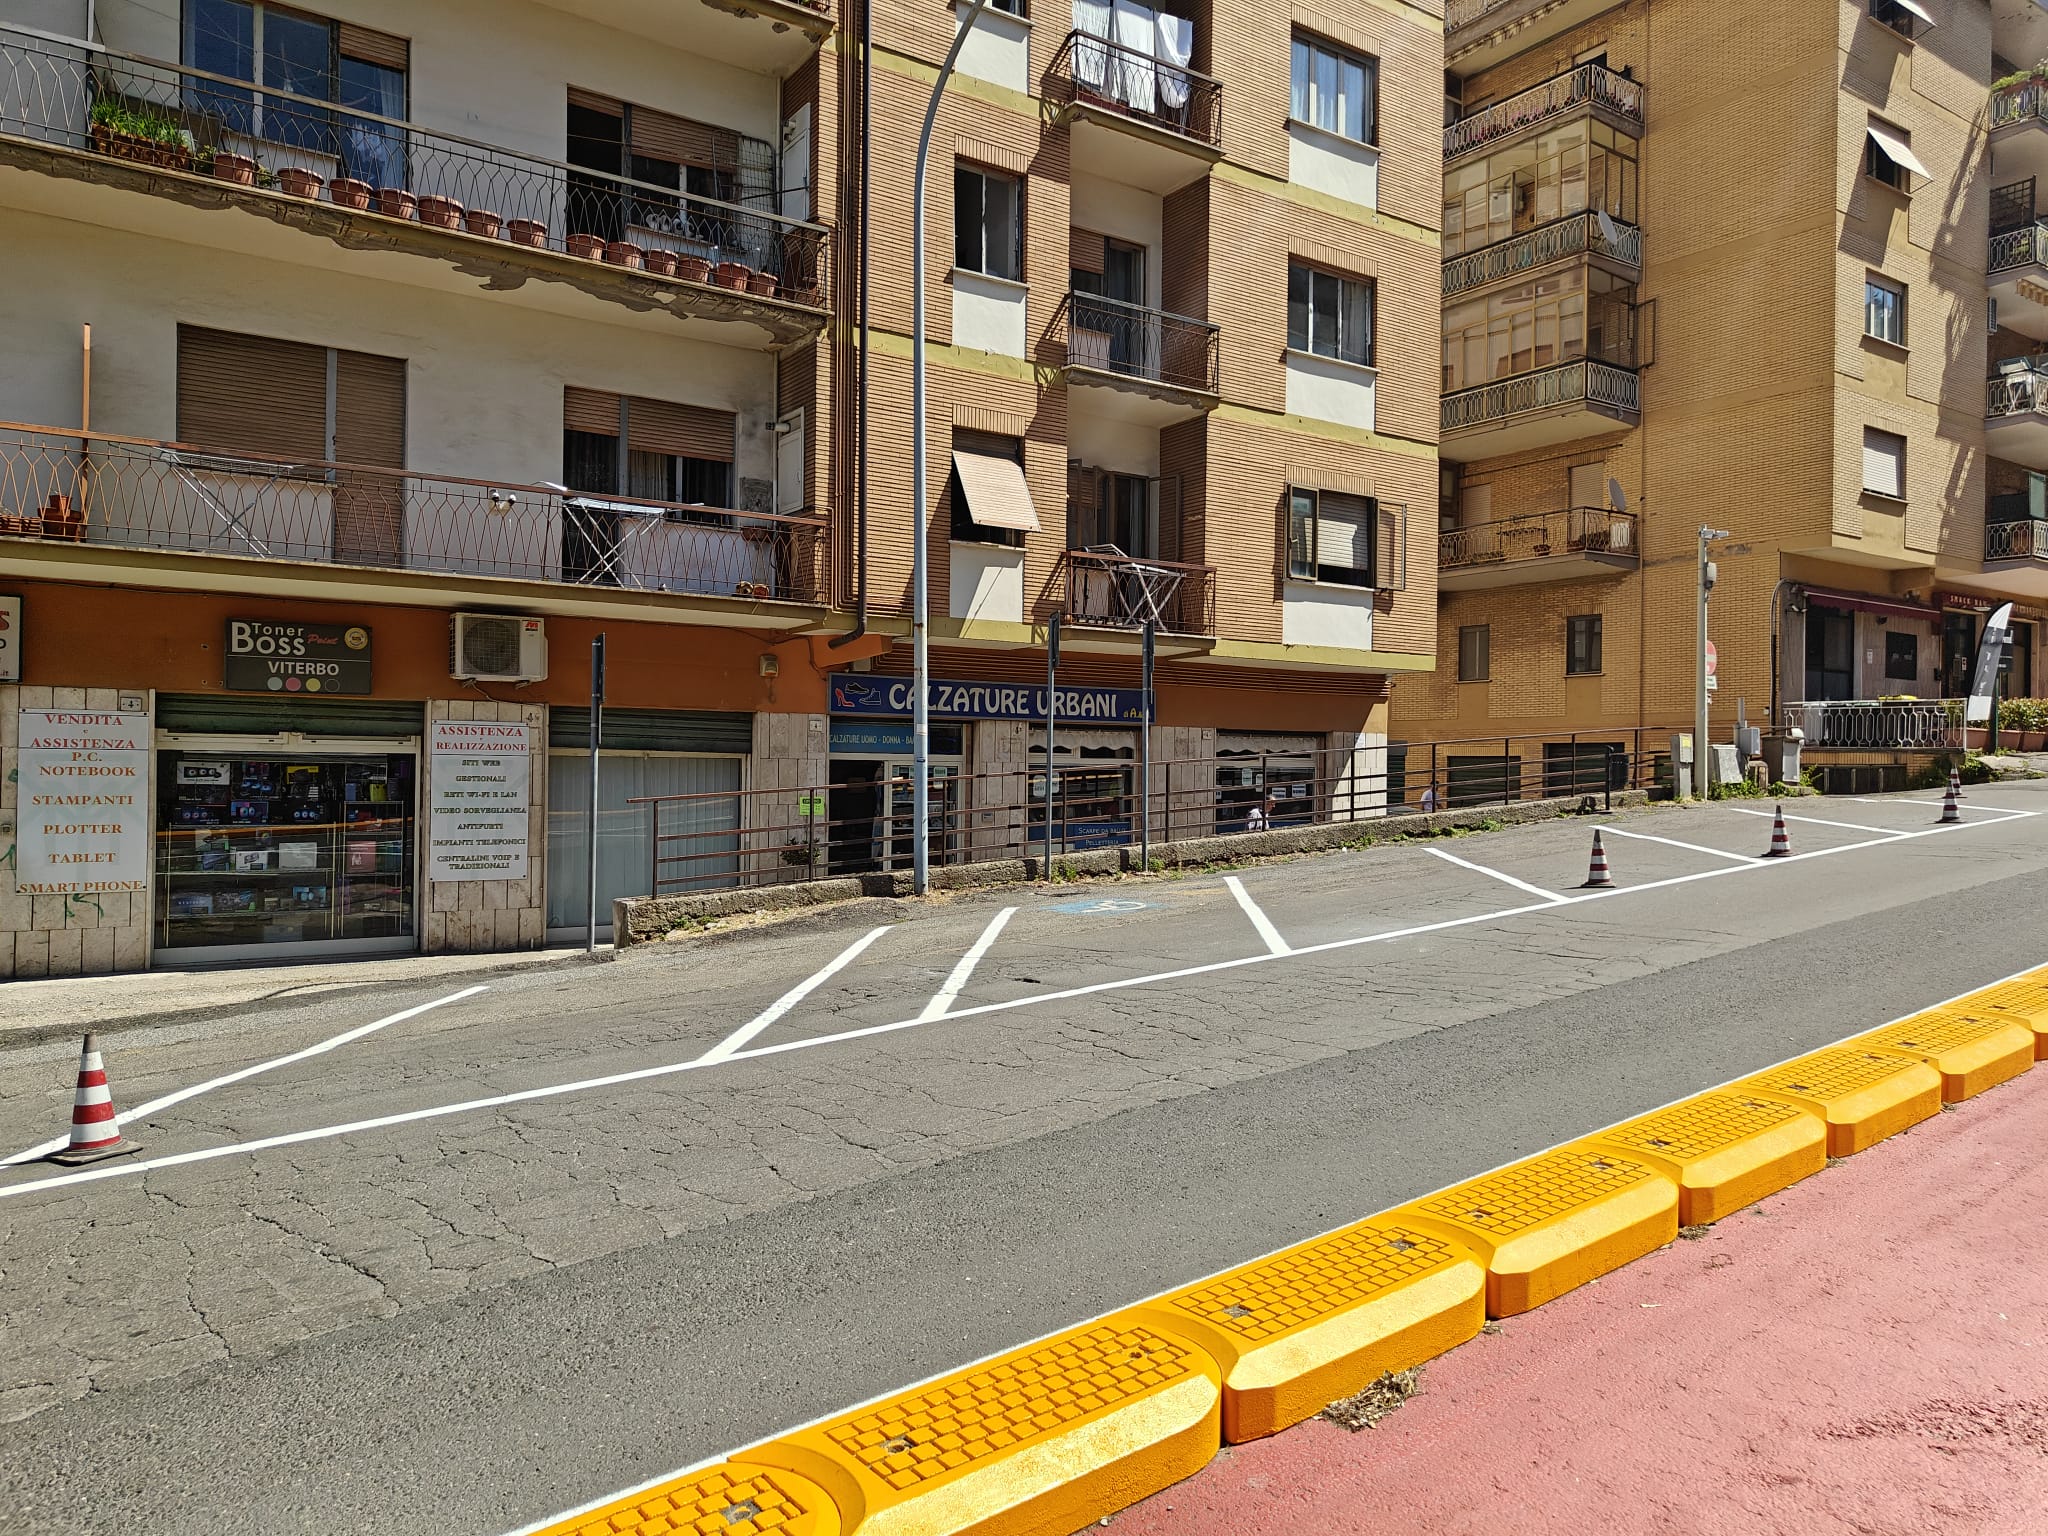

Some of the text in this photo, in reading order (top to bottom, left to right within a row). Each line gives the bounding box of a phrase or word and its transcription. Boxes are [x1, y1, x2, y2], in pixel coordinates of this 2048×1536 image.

[251, 622, 305, 637] Toner
[267, 660, 340, 676] VITERBO
[1036, 690, 1118, 718] URBANI
[44, 714, 124, 726] VENDITA
[438, 726, 523, 737] ASSISTENZA
[30, 737, 136, 749] ASSISTENZA
[829, 734, 860, 744] CALZATURE
[861, 734, 878, 744] UOMO
[882, 735, 901, 745] DONNA
[436, 741, 528, 752] REALIZZAZIONE
[71, 751, 103, 762] P.C.
[39, 765, 137, 777] NOTEBOOK
[455, 775, 507, 783] GESTIONALI
[32, 795, 135, 806] STAMPANTI
[43, 823, 124, 835] PLOTTER
[48, 852, 117, 864] TABLET
[19, 880, 144, 894] SMART PHONE
